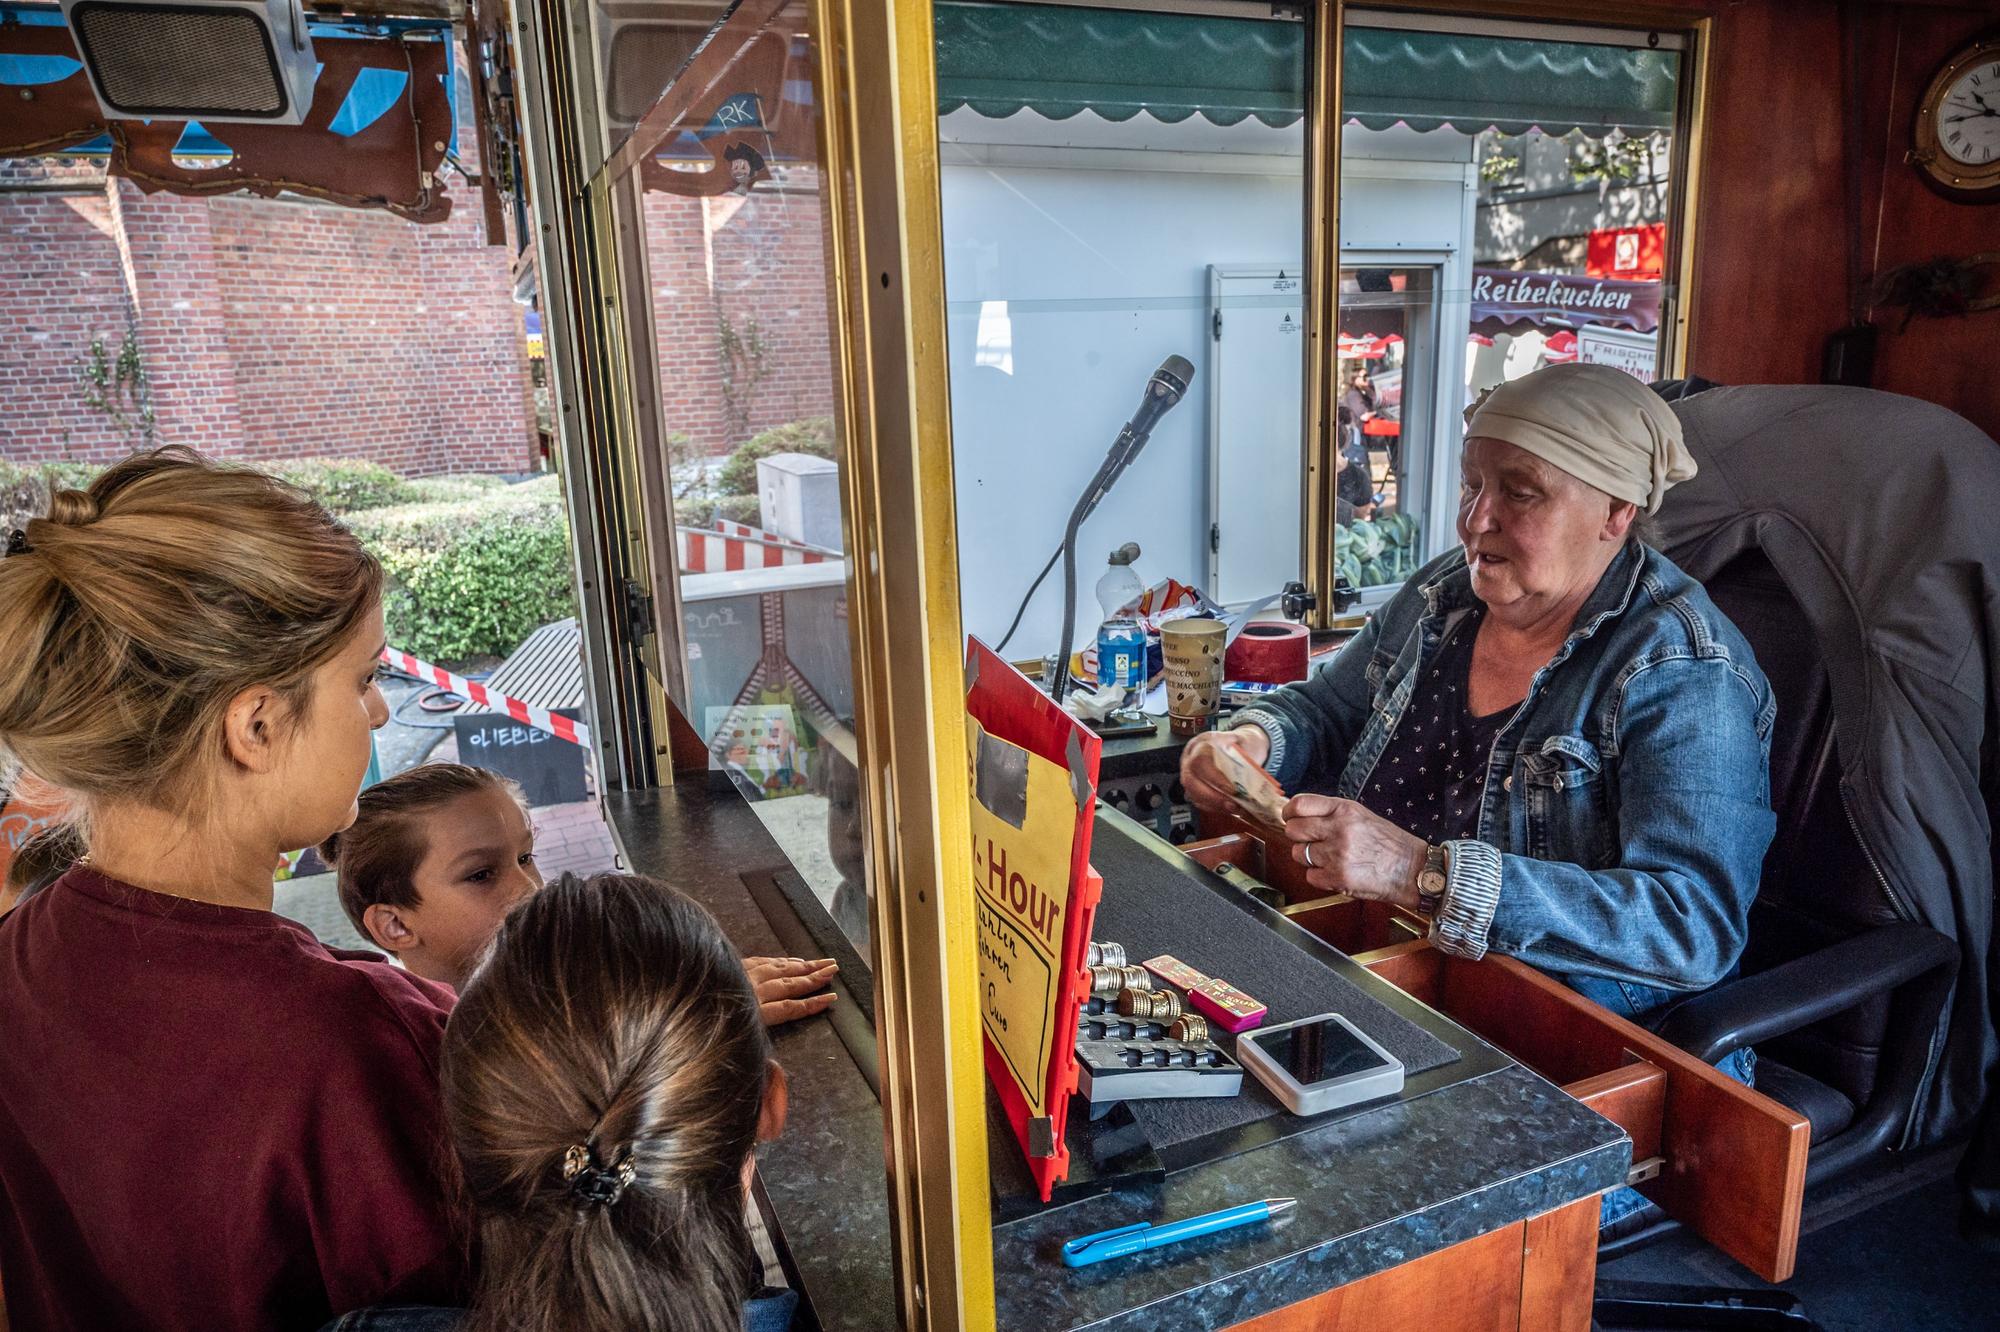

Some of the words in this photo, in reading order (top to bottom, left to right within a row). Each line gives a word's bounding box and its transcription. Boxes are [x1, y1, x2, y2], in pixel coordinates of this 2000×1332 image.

[1473, 275, 1633, 311] Reibekuchen
[1594, 343, 1656, 362] FRISCHE
[973, 833, 1061, 943] -Hour
